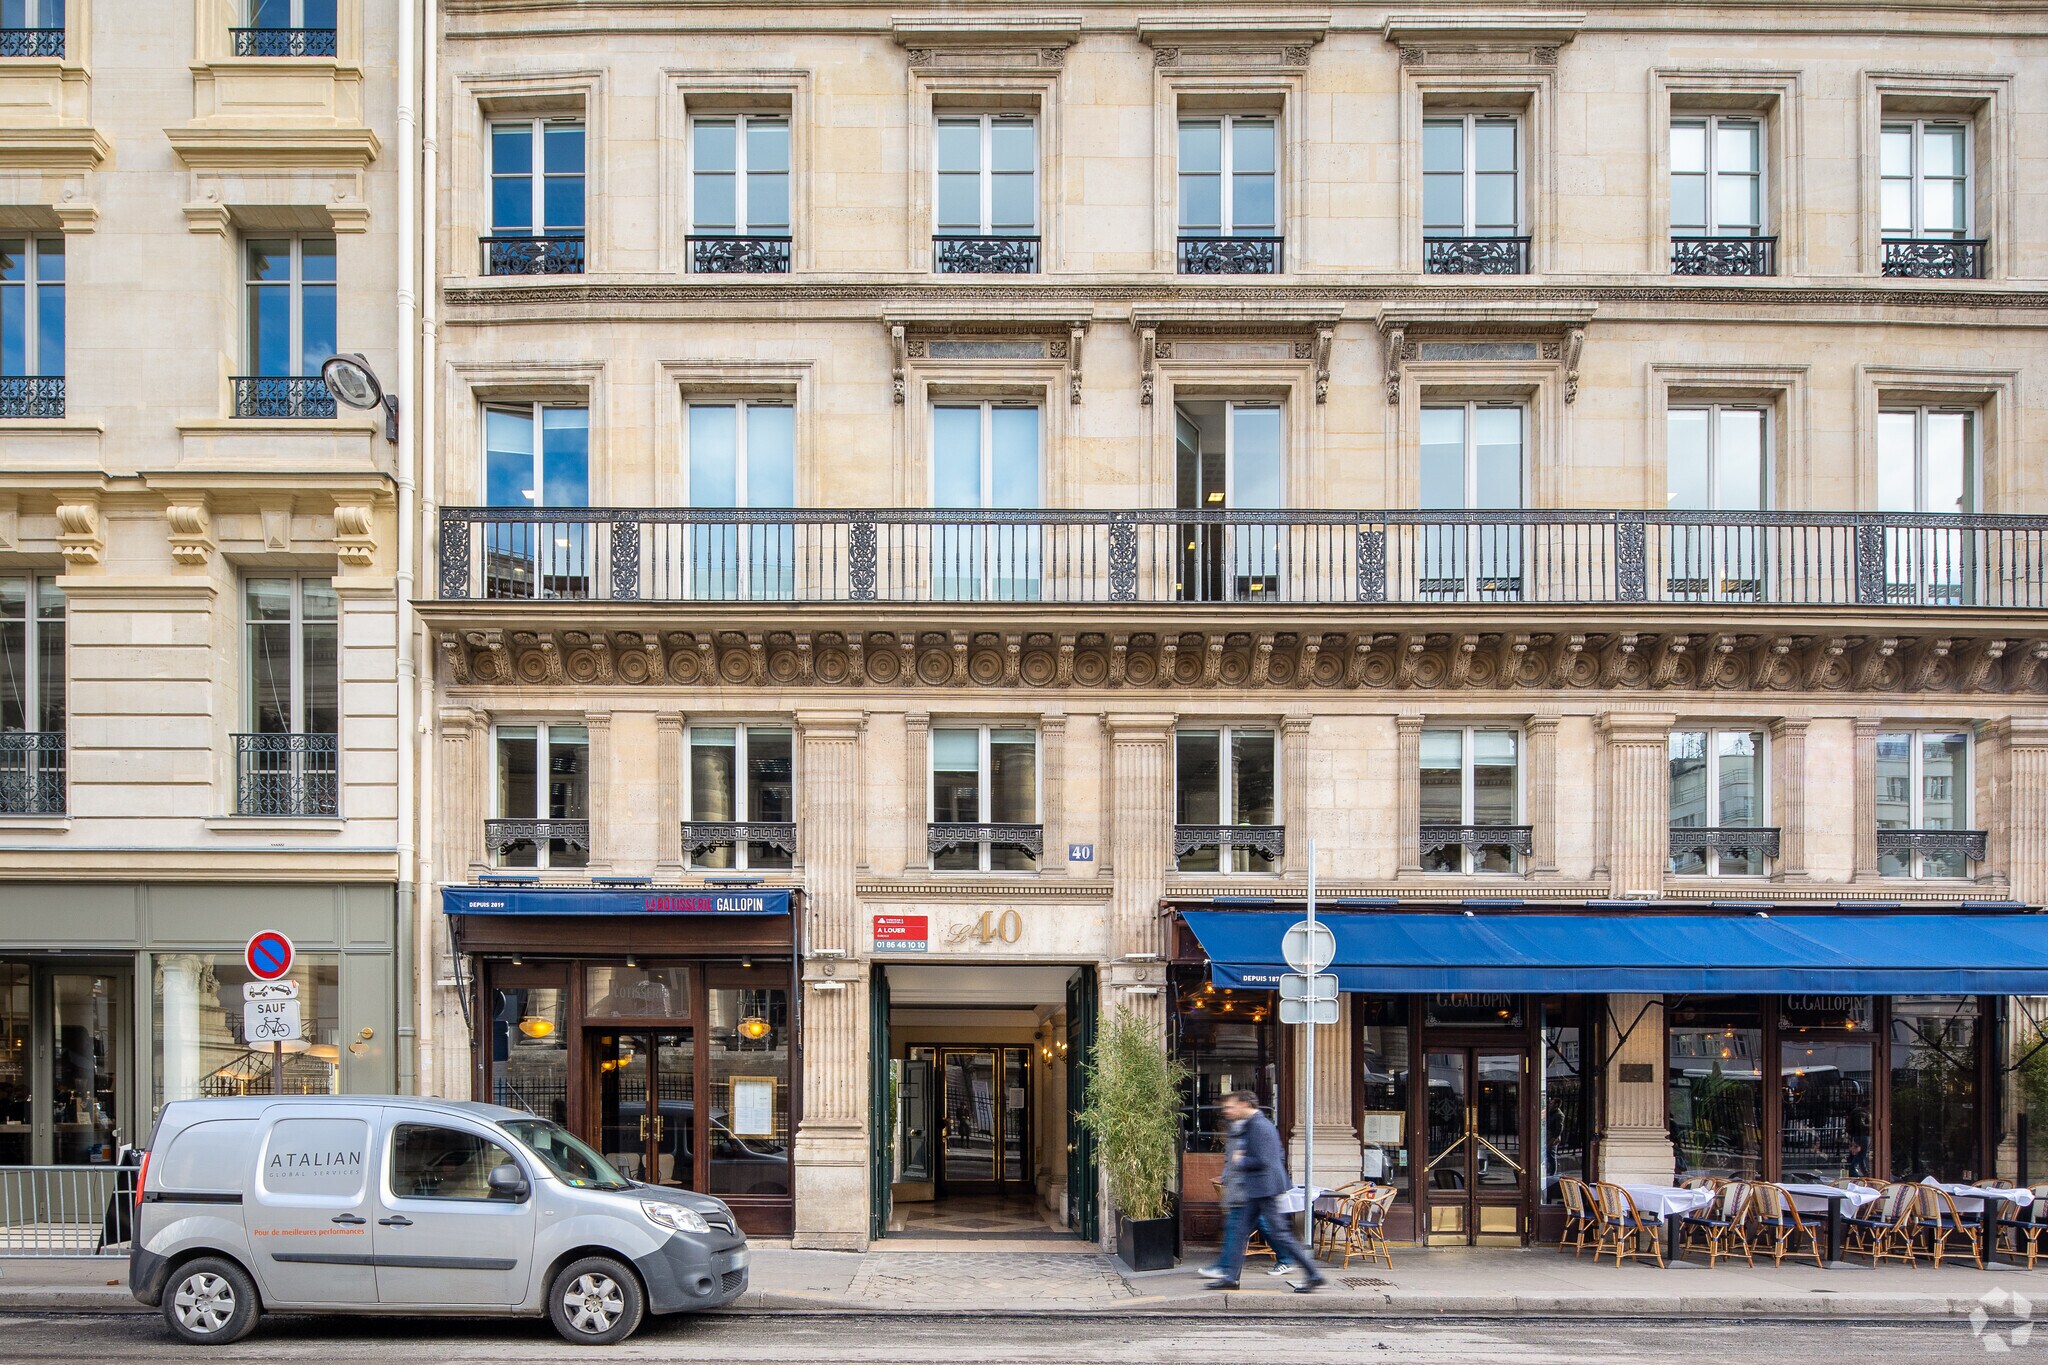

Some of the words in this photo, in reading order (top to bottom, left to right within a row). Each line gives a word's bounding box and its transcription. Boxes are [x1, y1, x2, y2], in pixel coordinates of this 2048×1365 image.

[1071, 846, 1090, 860] 40
[645, 898, 656, 912] LA
[716, 897, 763, 912] GALLOPIN
[944, 923, 972, 945] Le
[968, 909, 1023, 944] 40
[876, 941, 885, 949] 01
[907, 941, 916, 949] 10
[917, 941, 926, 949] 10
[257, 1003, 286, 1014] SAUF
[270, 1151, 361, 1168] ATALIAN
[313, 1169, 360, 1177] SERVICES
[281, 1228, 318, 1236] meilleures
[319, 1227, 365, 1237] performances
